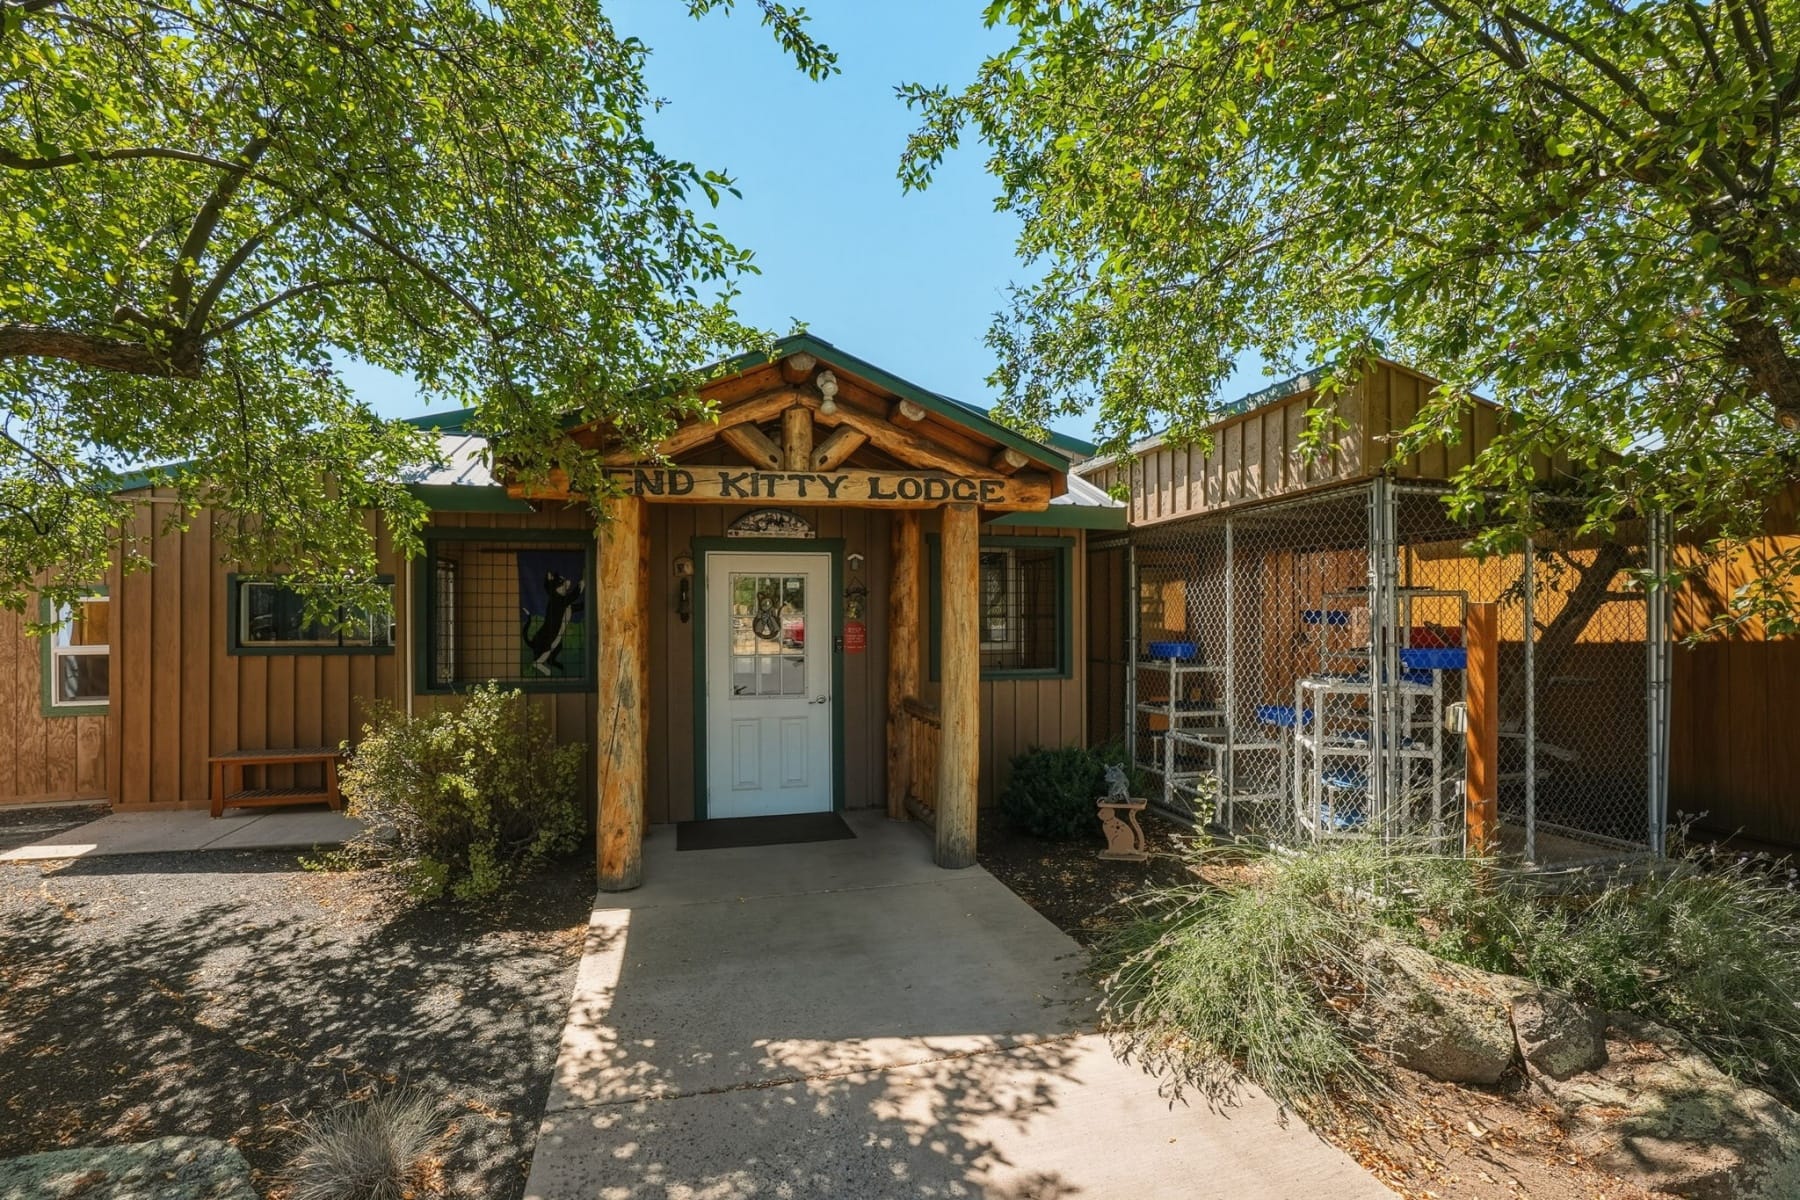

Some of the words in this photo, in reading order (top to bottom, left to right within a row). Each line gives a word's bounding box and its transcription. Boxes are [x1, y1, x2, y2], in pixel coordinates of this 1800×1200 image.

[567, 468, 695, 498] END
[718, 471, 848, 498] KITTY
[867, 476, 1006, 503] LODGE
